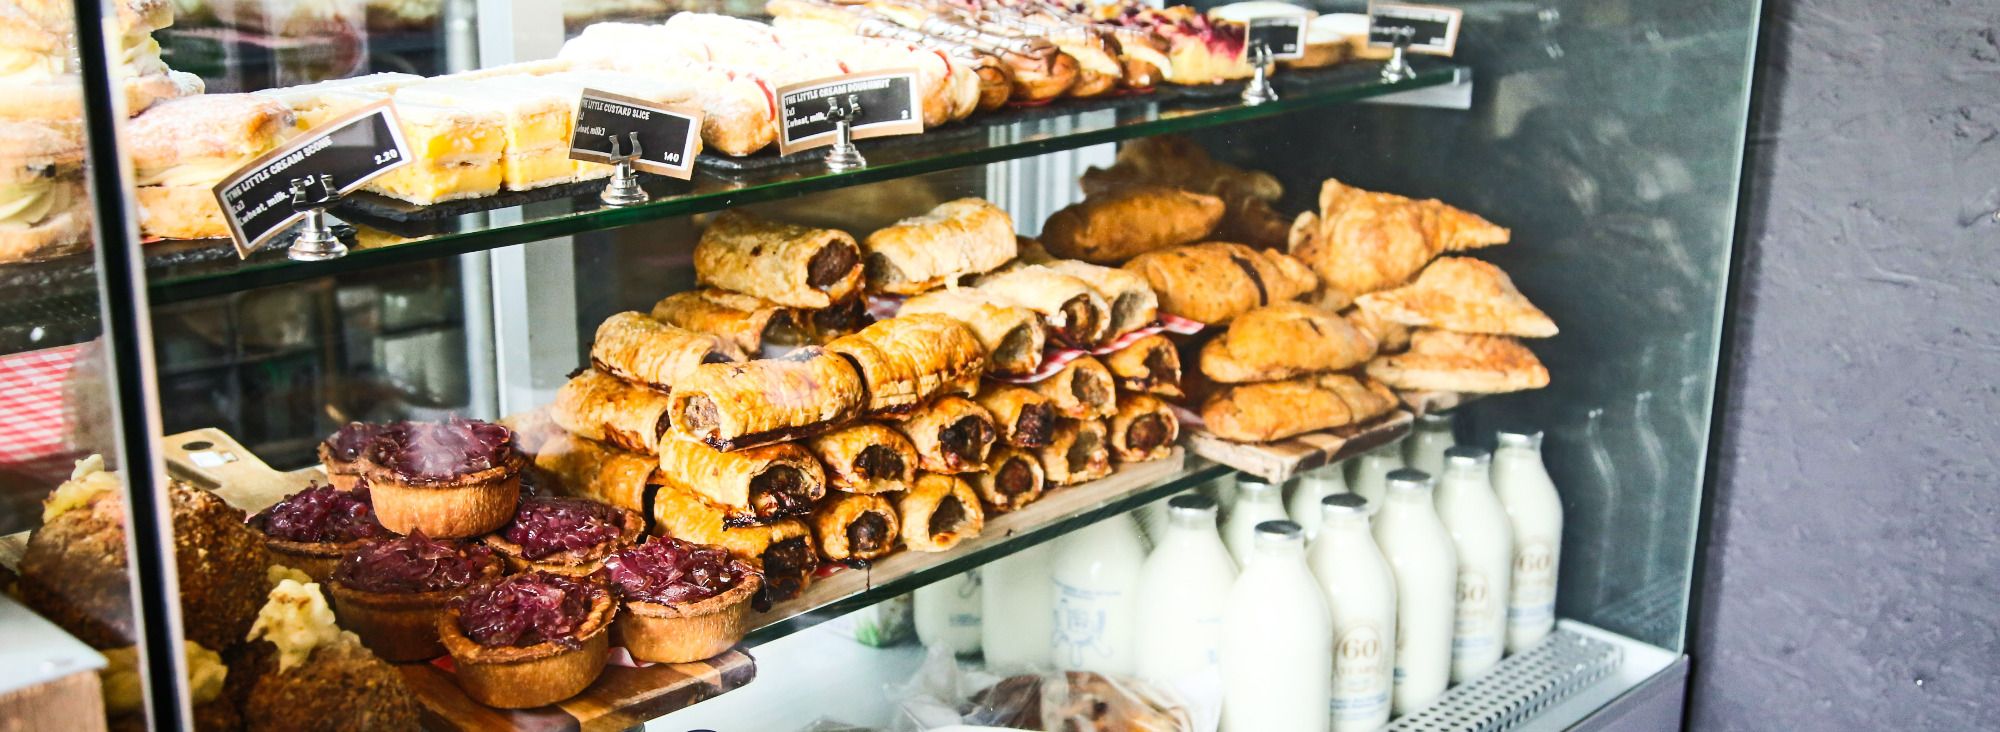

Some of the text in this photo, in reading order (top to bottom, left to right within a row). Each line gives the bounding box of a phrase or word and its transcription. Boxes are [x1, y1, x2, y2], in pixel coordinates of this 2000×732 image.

[785, 95, 796, 105] THE
[797, 90, 818, 102] LITTLE
[819, 84, 846, 98] CREAM
[588, 100, 604, 111] LITTLE
[604, 103, 631, 117] CUSTARD
[632, 108, 651, 120] SLICE
[374, 149, 398, 165] 2.20
[227, 136, 333, 201] THE LITTLE CREAM SCONE
[1343, 639, 1377, 660] 60
